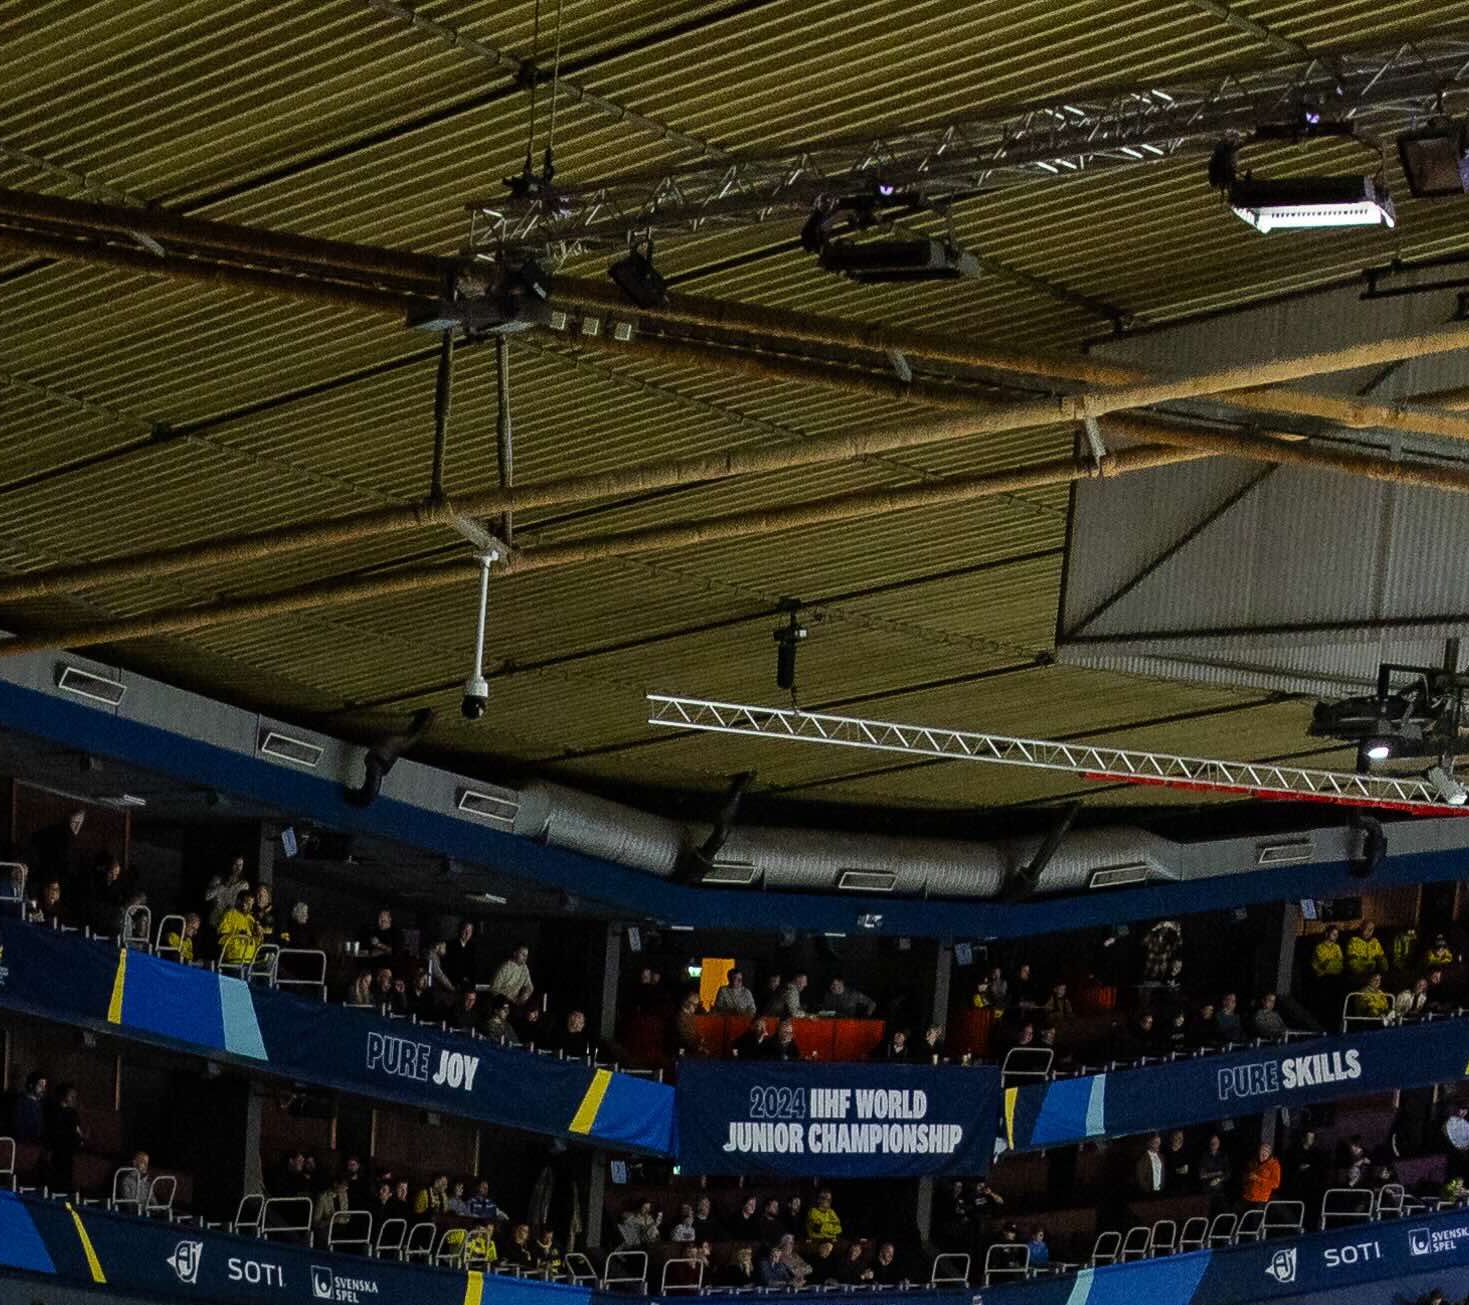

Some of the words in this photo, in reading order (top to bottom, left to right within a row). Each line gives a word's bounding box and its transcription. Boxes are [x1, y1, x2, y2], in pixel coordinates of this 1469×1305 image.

[366, 1031, 432, 1083] PURE
[432, 1049, 481, 1092] JOY
[1217, 1059, 1280, 1101] PURE
[1281, 1048, 1362, 1089] SKILLS
[749, 1085, 807, 1119] 2024
[809, 1088, 851, 1119] IIHF
[855, 1088, 928, 1120] WORLD
[722, 1121, 805, 1153] JUNIOR
[807, 1122, 964, 1154] CHAMPIONSHIP
[1323, 1240, 1382, 1268] SOTI
[1432, 1240, 1457, 1253] SPEL
[227, 1257, 284, 1288] SOTI
[333, 1275, 380, 1295] SVENSKA
[334, 1290, 360, 1304] SPEL
